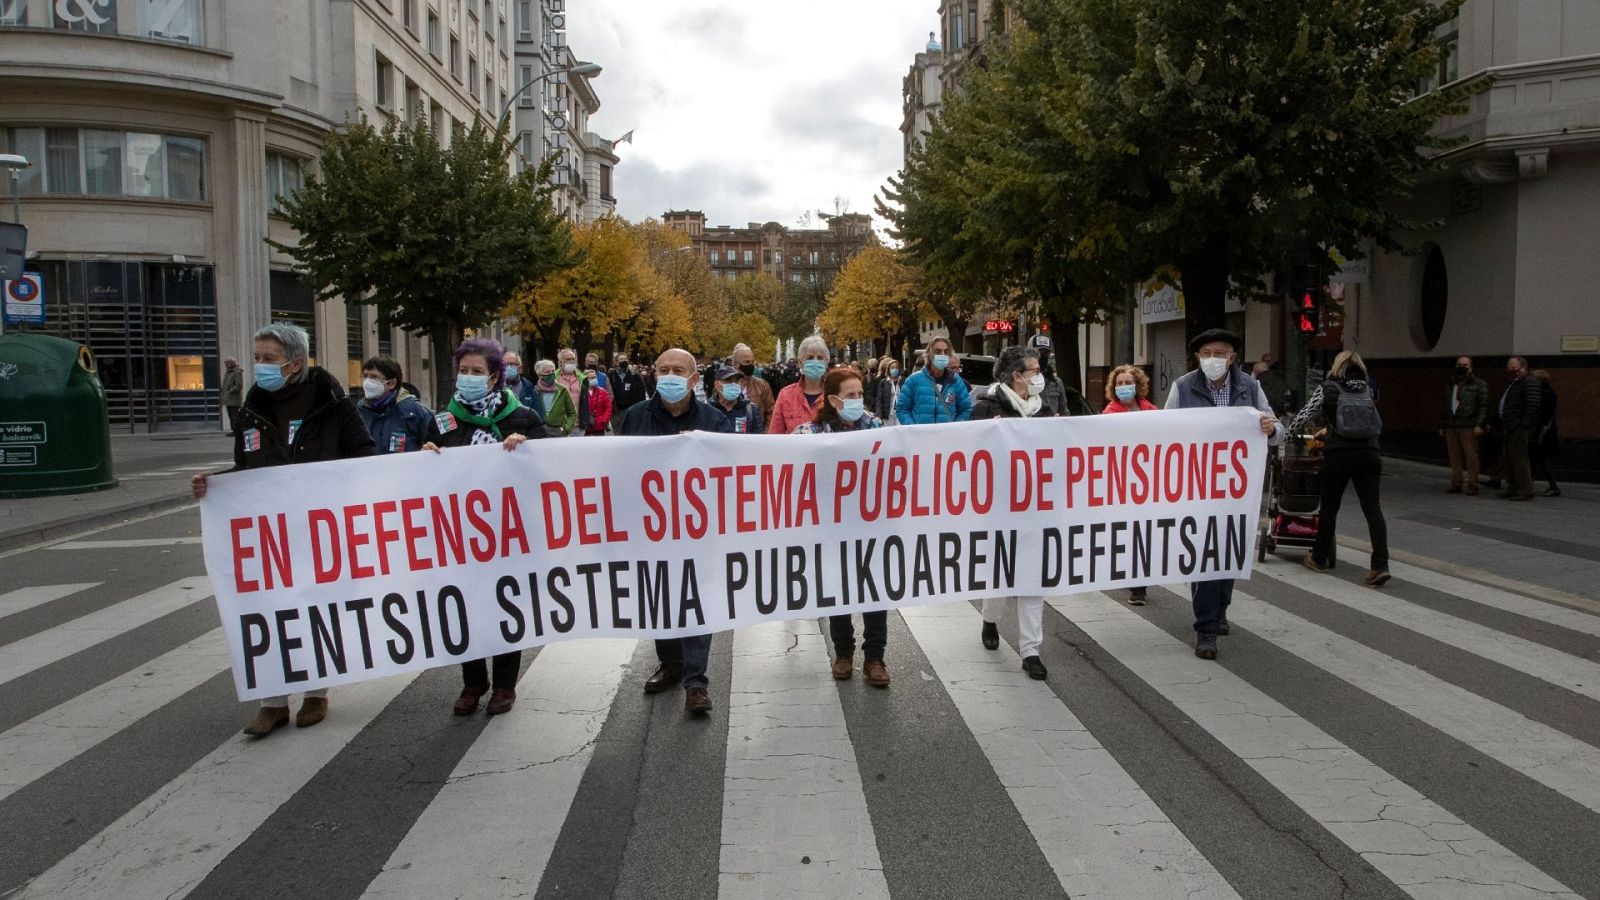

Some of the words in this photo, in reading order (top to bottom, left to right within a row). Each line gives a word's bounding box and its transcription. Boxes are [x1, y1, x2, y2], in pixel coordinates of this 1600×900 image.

[551, 0, 567, 82] HOTEL
[552, 96, 567, 184] YOLDI
[2, 433, 42, 441] bakarrik
[6, 425, 33, 433] vidrio
[231, 513, 293, 592] EN
[308, 487, 529, 584] DEFENSA
[541, 476, 629, 549] DEL
[641, 463, 819, 541] SISTEMA
[834, 440, 994, 523] PÚBLICO
[1010, 448, 1053, 511] DE
[1066, 440, 1248, 508] PENSIONES
[239, 584, 470, 690] PENTSIO
[495, 558, 706, 644] SISTEMA
[726, 529, 1017, 619] PUBLIKOAREN
[1041, 514, 1247, 588] DEFENTSAN
